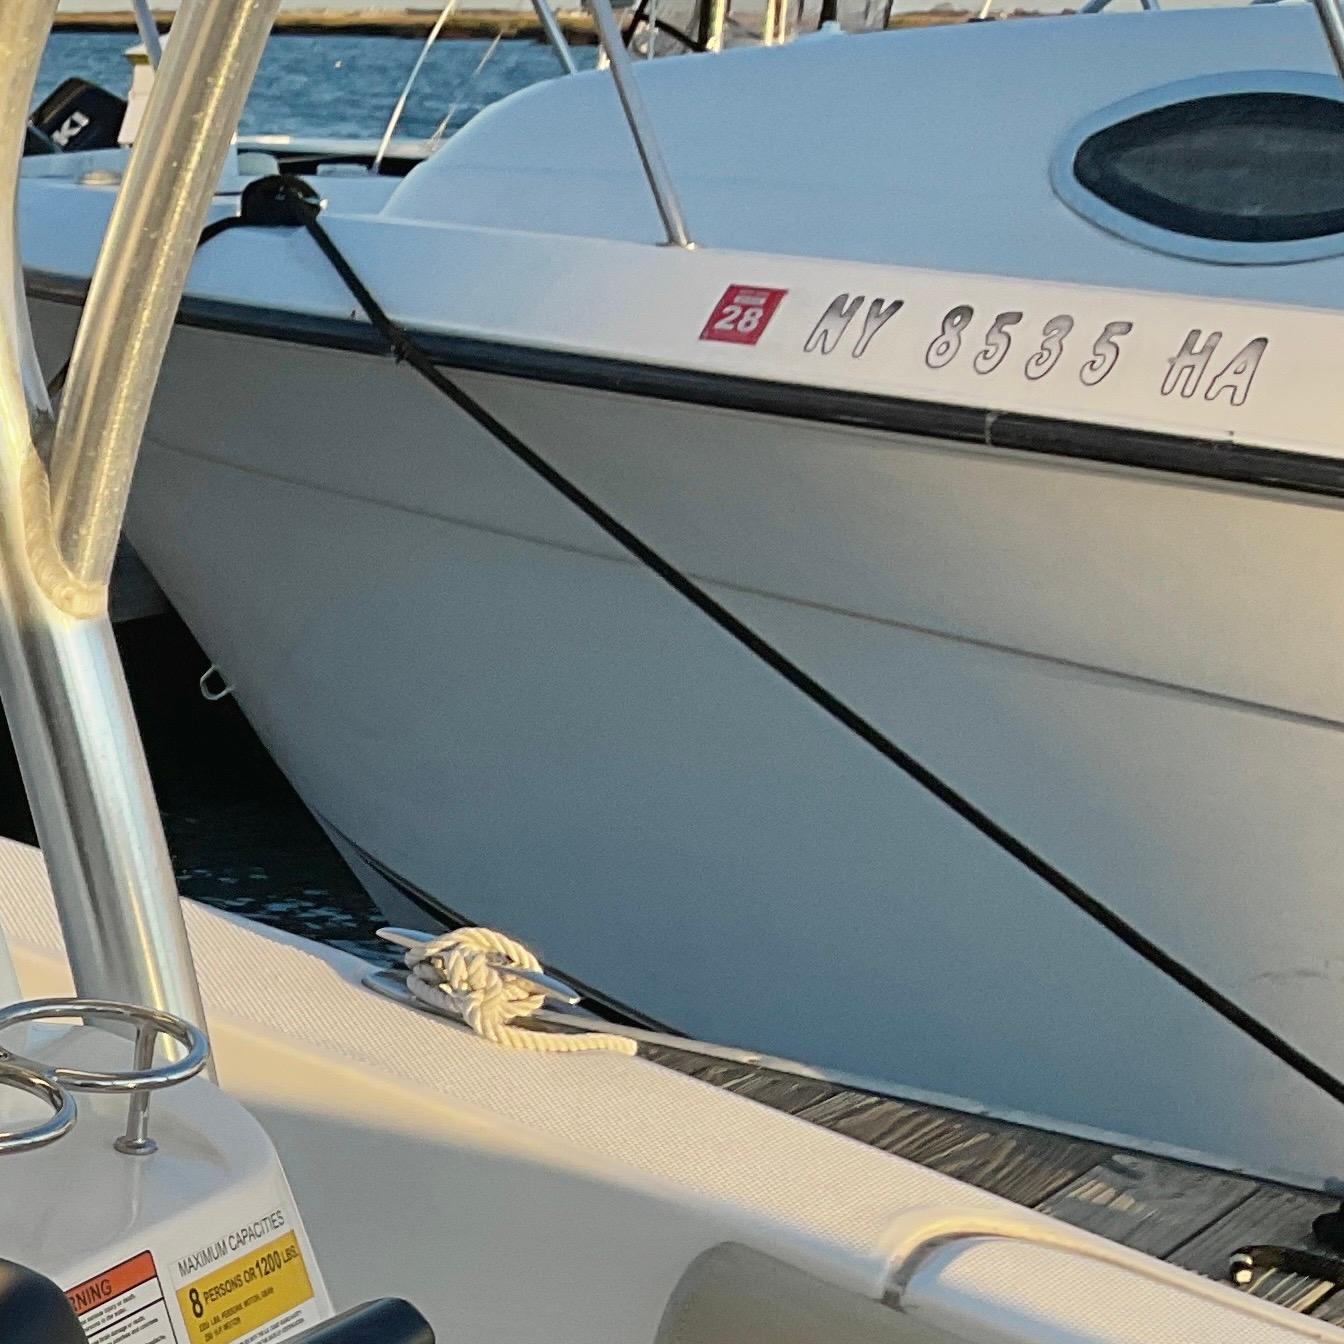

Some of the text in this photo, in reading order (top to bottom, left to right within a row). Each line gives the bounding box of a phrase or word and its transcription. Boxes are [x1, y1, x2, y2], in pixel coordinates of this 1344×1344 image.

[714, 304, 764, 333] 28
[803, 293, 1269, 406] NY 8535 HA
[177, 1210, 285, 1277] MAXIMUM CAPACITIES
[189, 1287, 204, 1318] 8
[203, 1273, 244, 1305] PERSONS
[243, 1266, 257, 1284] OR
[255, 1250, 282, 1278] 1200
